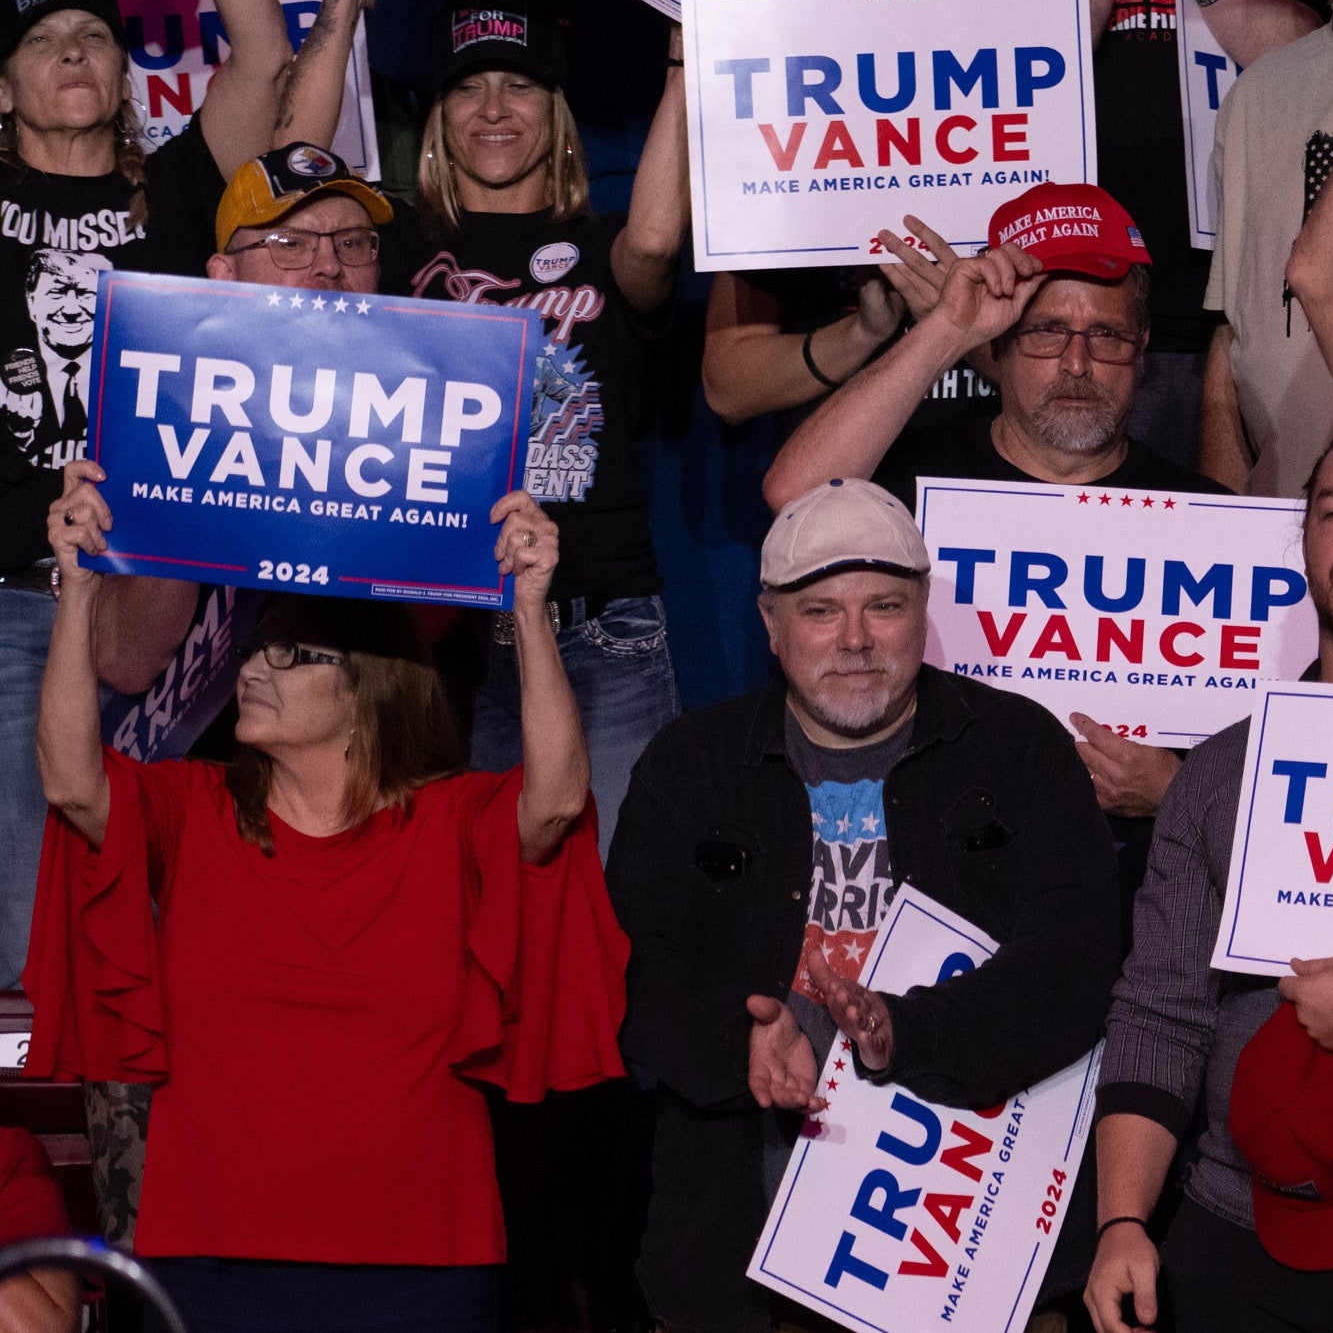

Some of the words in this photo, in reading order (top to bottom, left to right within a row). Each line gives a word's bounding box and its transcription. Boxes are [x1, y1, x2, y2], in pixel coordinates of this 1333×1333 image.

[454, 19, 525, 44] TRUMP
[471, 11, 504, 23] FOR
[714, 46, 1066, 121] TRUMP
[758, 113, 1030, 172] VANCE
[41, 207, 146, 252] MISSE
[998, 213, 1032, 245] MAKE
[1035, 205, 1103, 226] AMERICA
[1053, 222, 1099, 242] AGAIN
[536, 256, 575, 266] TRUMP
[121, 350, 502, 446] TRUMP
[158, 424, 451, 504] VANCE
[133, 483, 193, 503] MAKE
[202, 490, 301, 513] AMERICA
[310, 500, 382, 520] GREAT
[390, 508, 467, 528] AGAIN!
[258, 560, 329, 585] 2024
[938, 547, 1309, 621] TRUMP
[977, 611, 1261, 669] VANCE
[941, 1265, 969, 1321] MAKE
[965, 1172, 1004, 1260] AMERICA
[1000, 1098, 1028, 1163] GREAT
[1036, 1169, 1066, 1234] 2024
